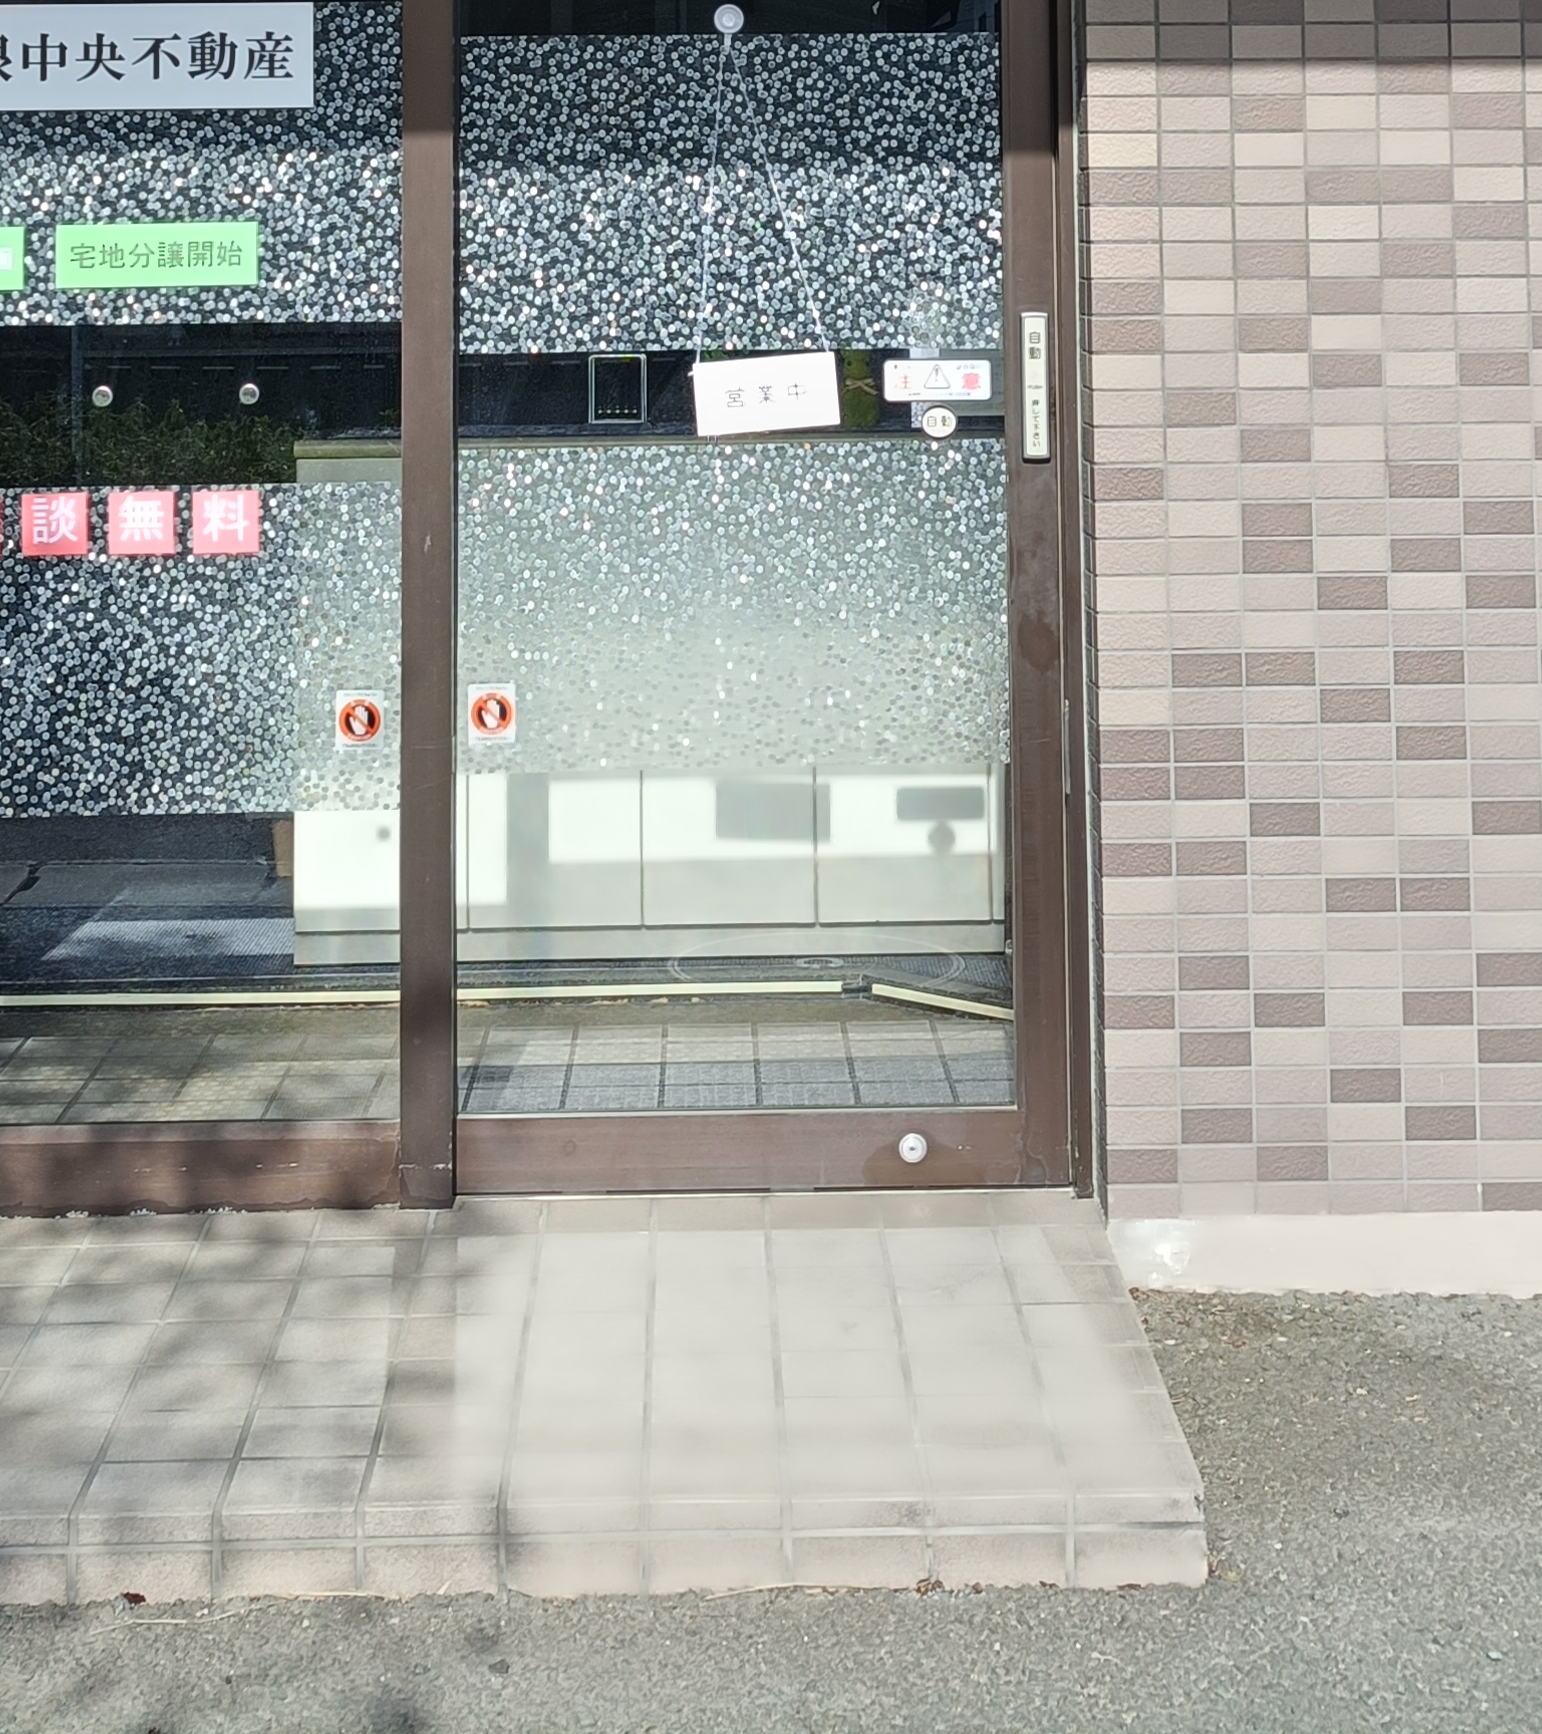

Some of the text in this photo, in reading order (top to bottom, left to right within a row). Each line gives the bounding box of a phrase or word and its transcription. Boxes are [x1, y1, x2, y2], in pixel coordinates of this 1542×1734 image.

[69, 240, 244, 269] 宅地分譲開始
[1028, 331, 1041, 360] 自動
[724, 382, 807, 408] 営業中
[926, 415, 953, 428] 自動
